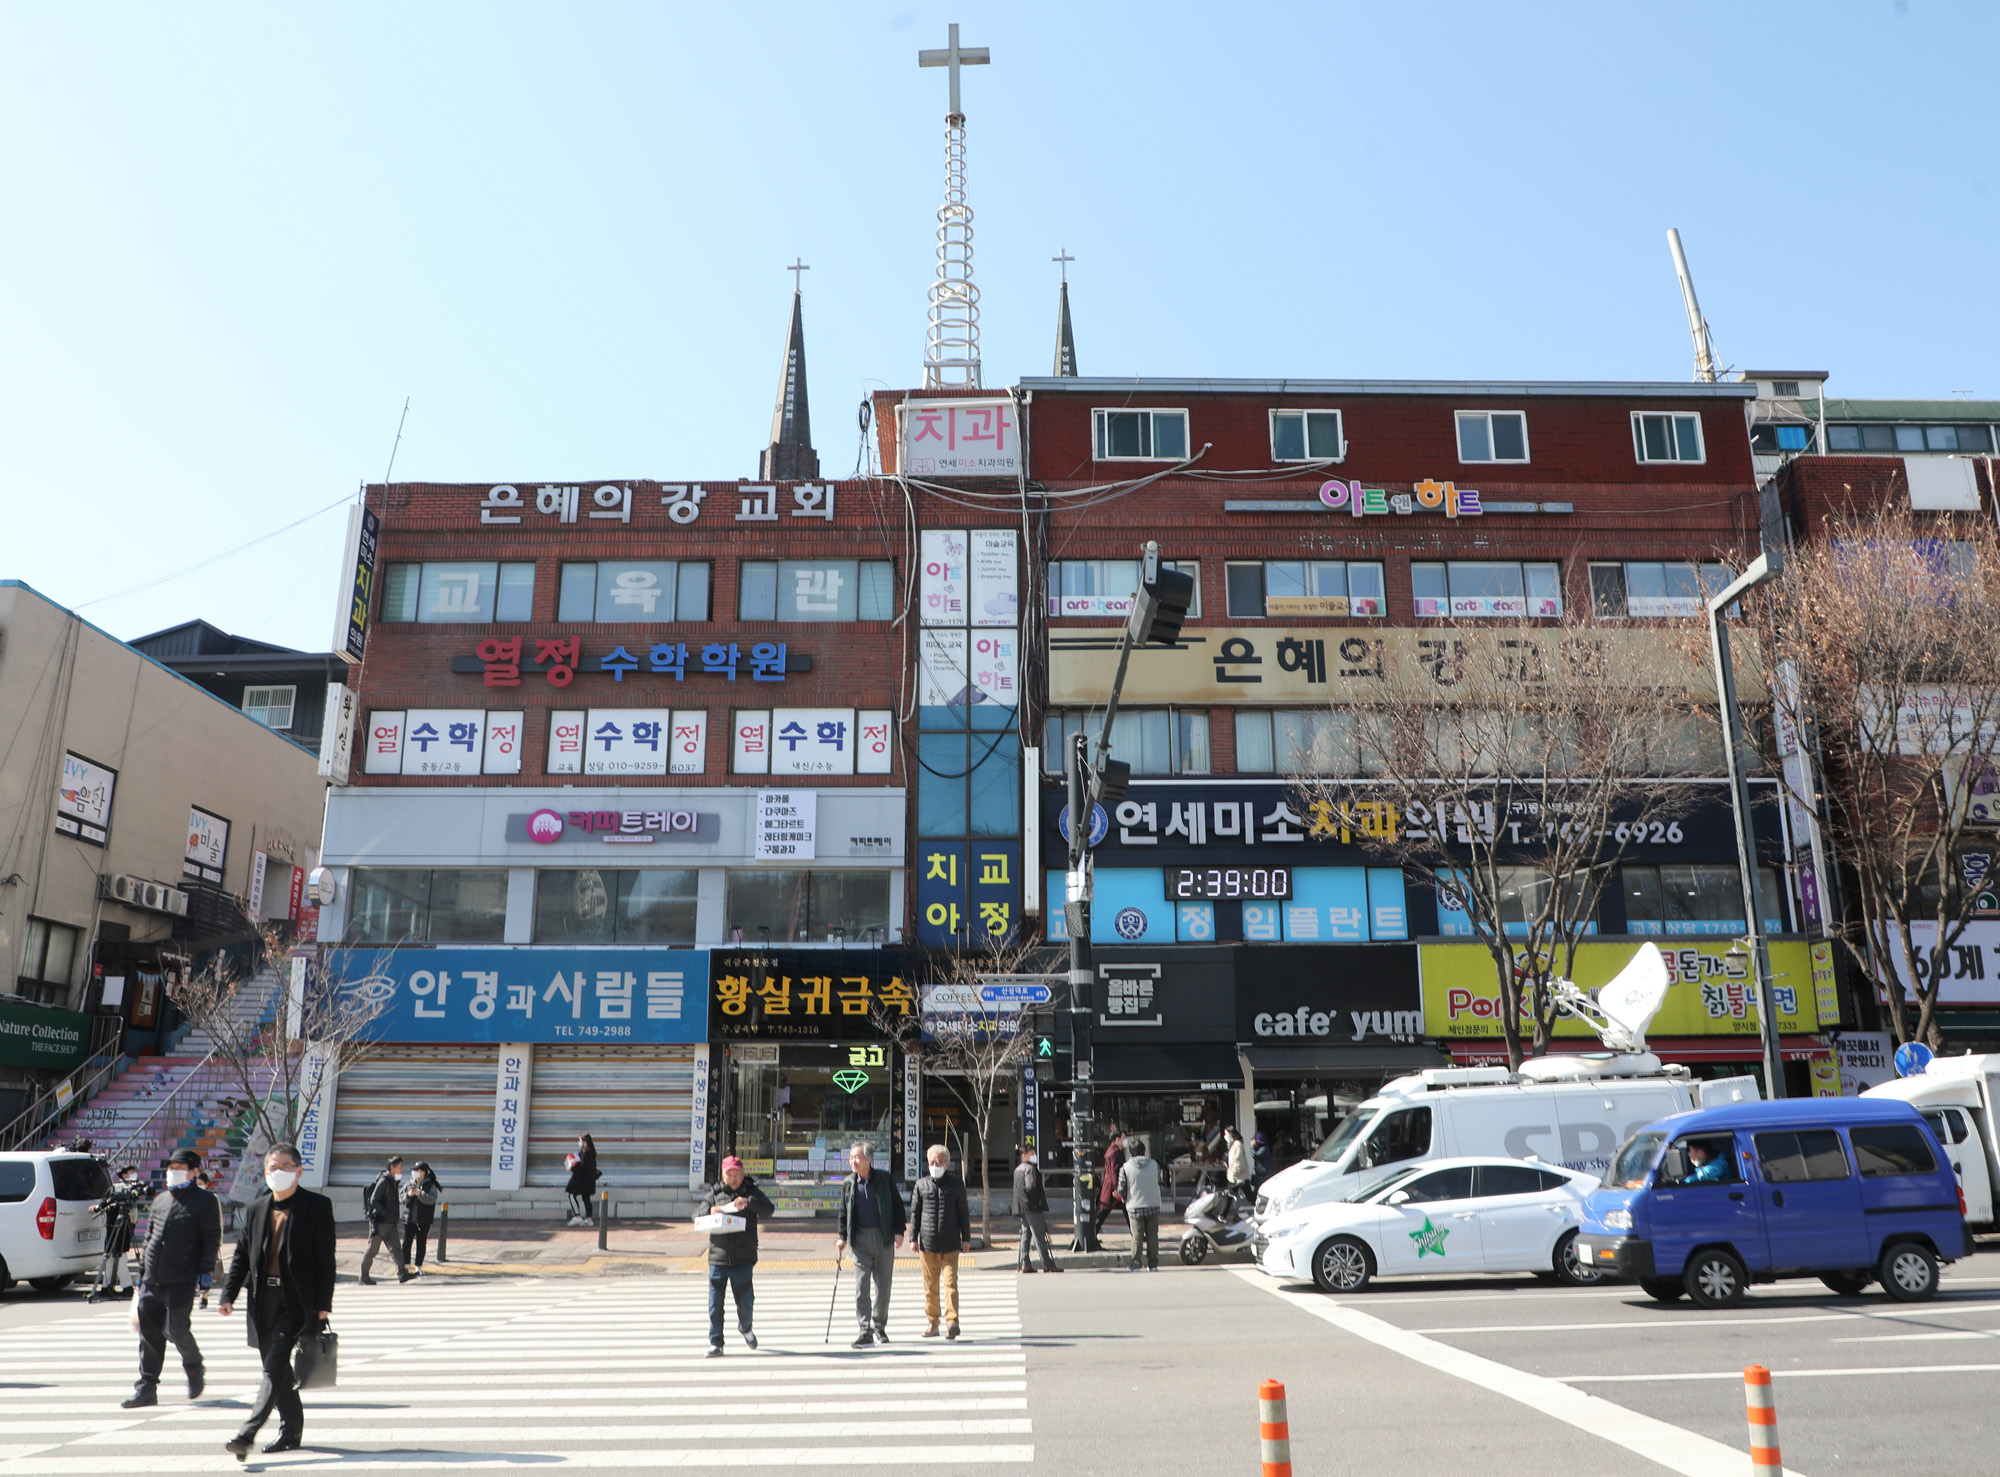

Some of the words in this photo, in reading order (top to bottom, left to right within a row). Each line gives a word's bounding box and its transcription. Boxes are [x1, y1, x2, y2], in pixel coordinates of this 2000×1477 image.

[913, 405, 1011, 451] 치과
[938, 457, 1014, 468] 연세미소치과의원
[480, 483, 633, 524] 은혜의
[660, 484, 707, 524] 강
[735, 482, 835, 522] 교회
[1319, 479, 1389, 518] 아트
[1413, 478, 1484, 519] 하트
[926, 562, 962, 581] 아트
[352, 563, 371, 632] 치과
[927, 592, 962, 613] 하트
[1066, 599, 1089, 610] art
[1454, 599, 1478, 611] art
[976, 638, 1013, 659] 아트
[475, 635, 581, 688] 열정
[600, 641, 787, 682] 수학학원
[1213, 637, 1384, 683] 은혜의
[977, 670, 1013, 692] 하트
[374, 724, 399, 754] 열
[410, 722, 478, 752] 수학
[491, 724, 516, 754] 정
[555, 724, 580, 752] 열
[594, 721, 662, 752] 수학
[675, 724, 700, 753] 정
[739, 724, 765, 753] 열
[778, 721, 847, 752] 수학
[863, 724, 887, 753] 정
[64, 757, 88, 780] IVY
[190, 812, 208, 831] IVY
[568, 810, 699, 834] 커피트레이
[200, 829, 220, 863] 미술
[763, 845, 796, 854] 구름과자
[1176, 869, 1288, 898] 2:39:00
[716, 974, 915, 1016] 황실귀금속
[1001, 986, 1029, 995] 산성대로
[1108, 978, 1154, 997] 올바른
[1107, 997, 1139, 1014] 빵집
[0, 1020, 31, 1036] Nature
[32, 1023, 79, 1041] Collection
[554, 1025, 574, 1036] TEL
[578, 1025, 631, 1036] 749-2988
[1351, 1009, 1425, 1042] yum
[1847, 1054, 1886, 1068] 맛있다!
